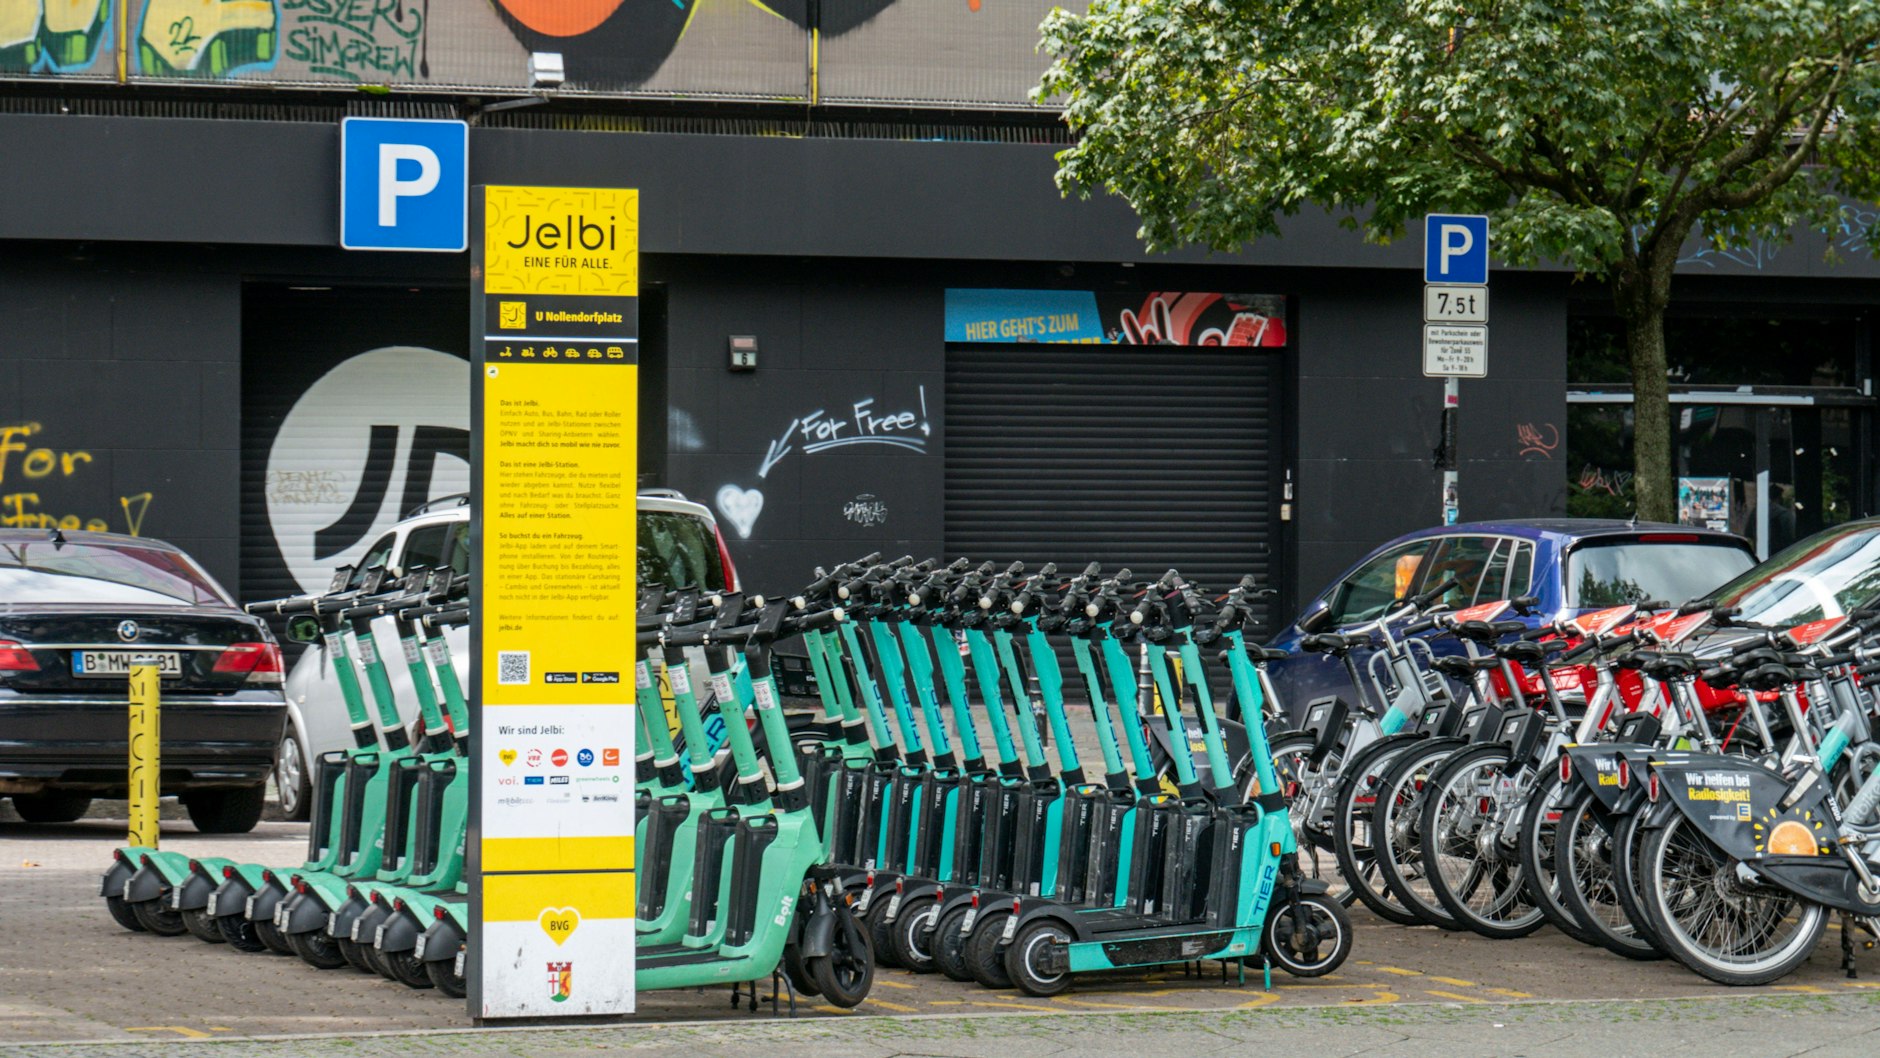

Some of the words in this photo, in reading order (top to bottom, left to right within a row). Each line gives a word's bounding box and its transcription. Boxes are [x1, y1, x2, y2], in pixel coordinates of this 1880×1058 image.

[378, 143, 441, 227] P
[507, 215, 616, 251] Jelbi
[1440, 223, 1474, 275] P
[524, 256, 551, 268] EINE
[554, 255, 577, 269] FÜR
[581, 257, 613, 270] ALLE.
[535, 311, 543, 322] U
[546, 311, 623, 325] Nollendorfplatz
[965, 320, 998, 341] HIER
[1000, 316, 1047, 338] GEHT'S
[1048, 313, 1080, 333] ZUM
[741, 352, 748, 366] 6
[800, 409, 847, 441] For
[854, 385, 931, 437] Free!
[85, 654, 97, 671] B
[498, 726, 515, 735] Wir
[517, 725, 538, 735] sind
[539, 725, 565, 735] Jelbi:
[1685, 772, 1704, 785] Wir
[1705, 773, 1735, 786] helfen
[1735, 774, 1751, 787] bei
[973, 790, 981, 812] TIER
[1002, 793, 1010, 816] TIER
[1687, 787, 1751, 804] Radlosigkeit!
[1109, 808, 1118, 831] TIER
[1184, 818, 1192, 842] TIER
[1231, 827, 1240, 851] TIER
[1252, 863, 1276, 917] TIER
[774, 895, 794, 927] Bolt
[550, 920, 569, 931] BVG
